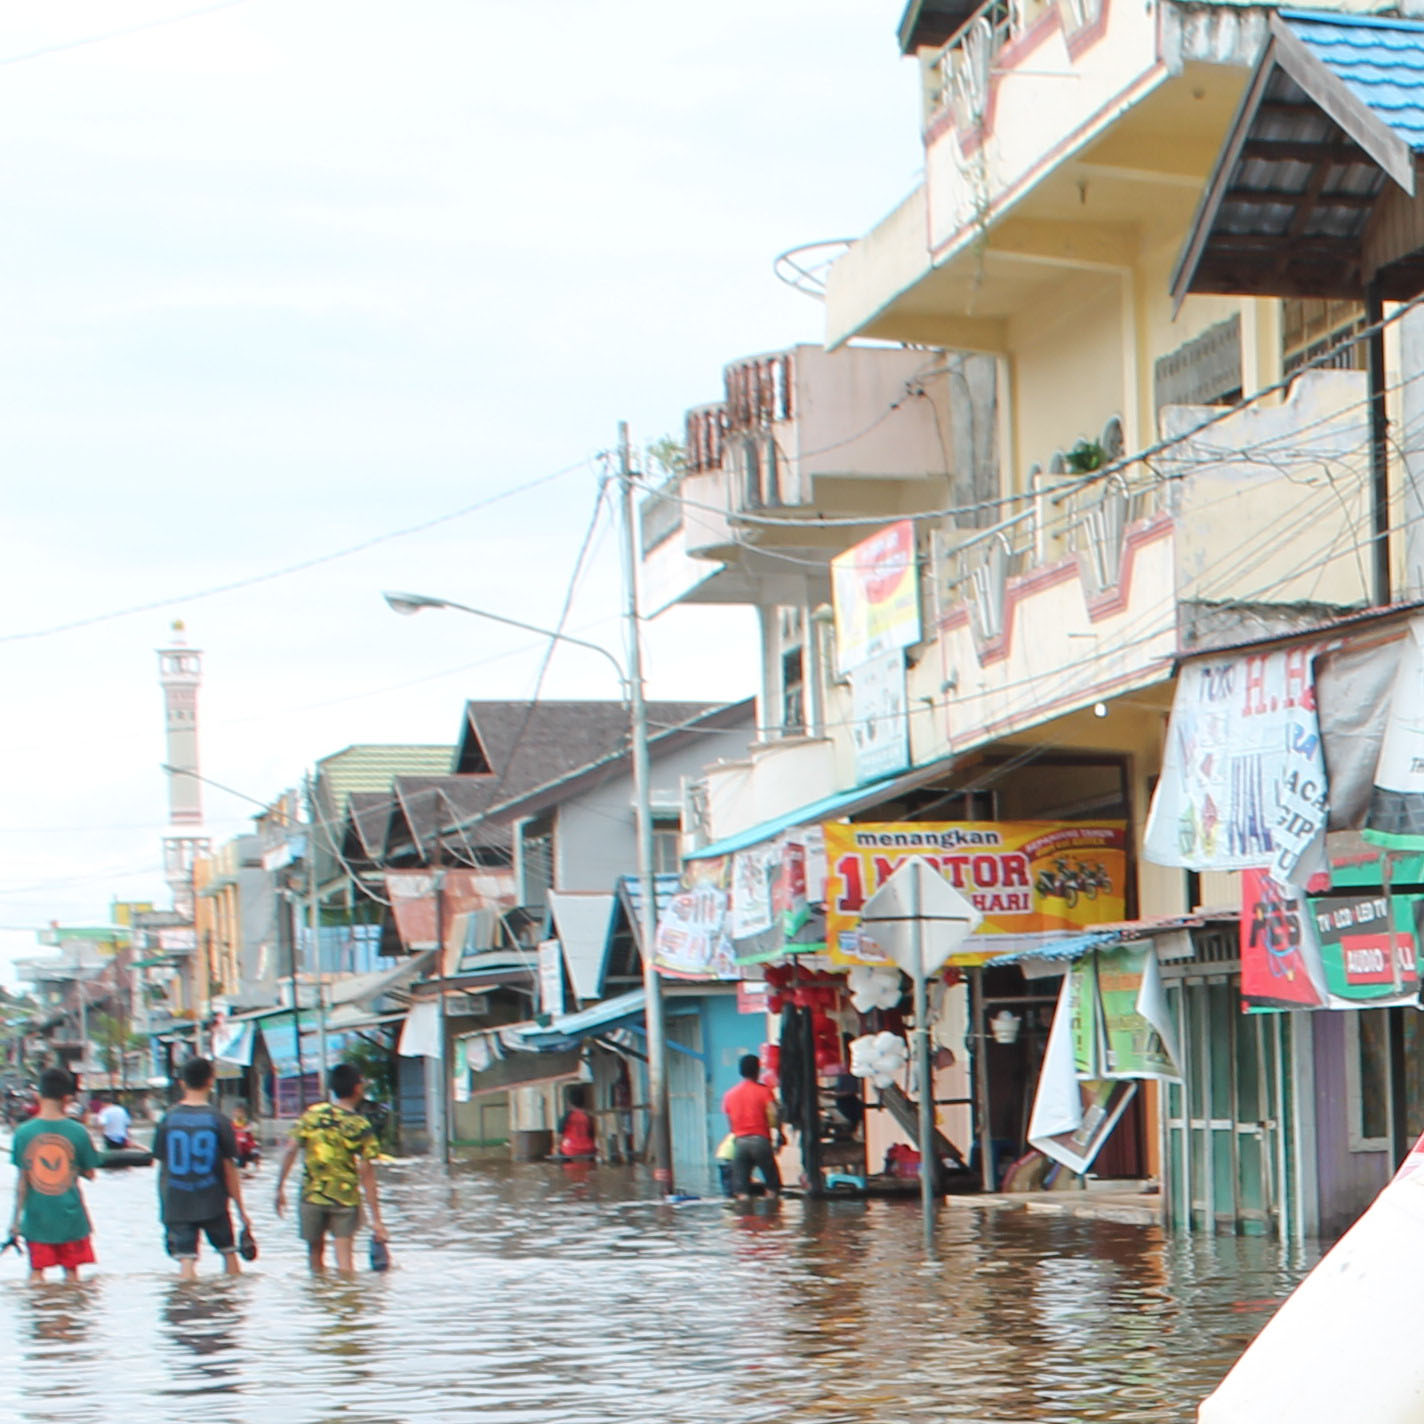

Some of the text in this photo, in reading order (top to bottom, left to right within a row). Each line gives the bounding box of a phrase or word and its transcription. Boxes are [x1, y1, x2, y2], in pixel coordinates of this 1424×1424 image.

[856, 829, 1000, 848] menangkan
[837, 855, 866, 912] 1
[971, 894, 1031, 912] HARI
[166, 1129, 218, 1176] 09
